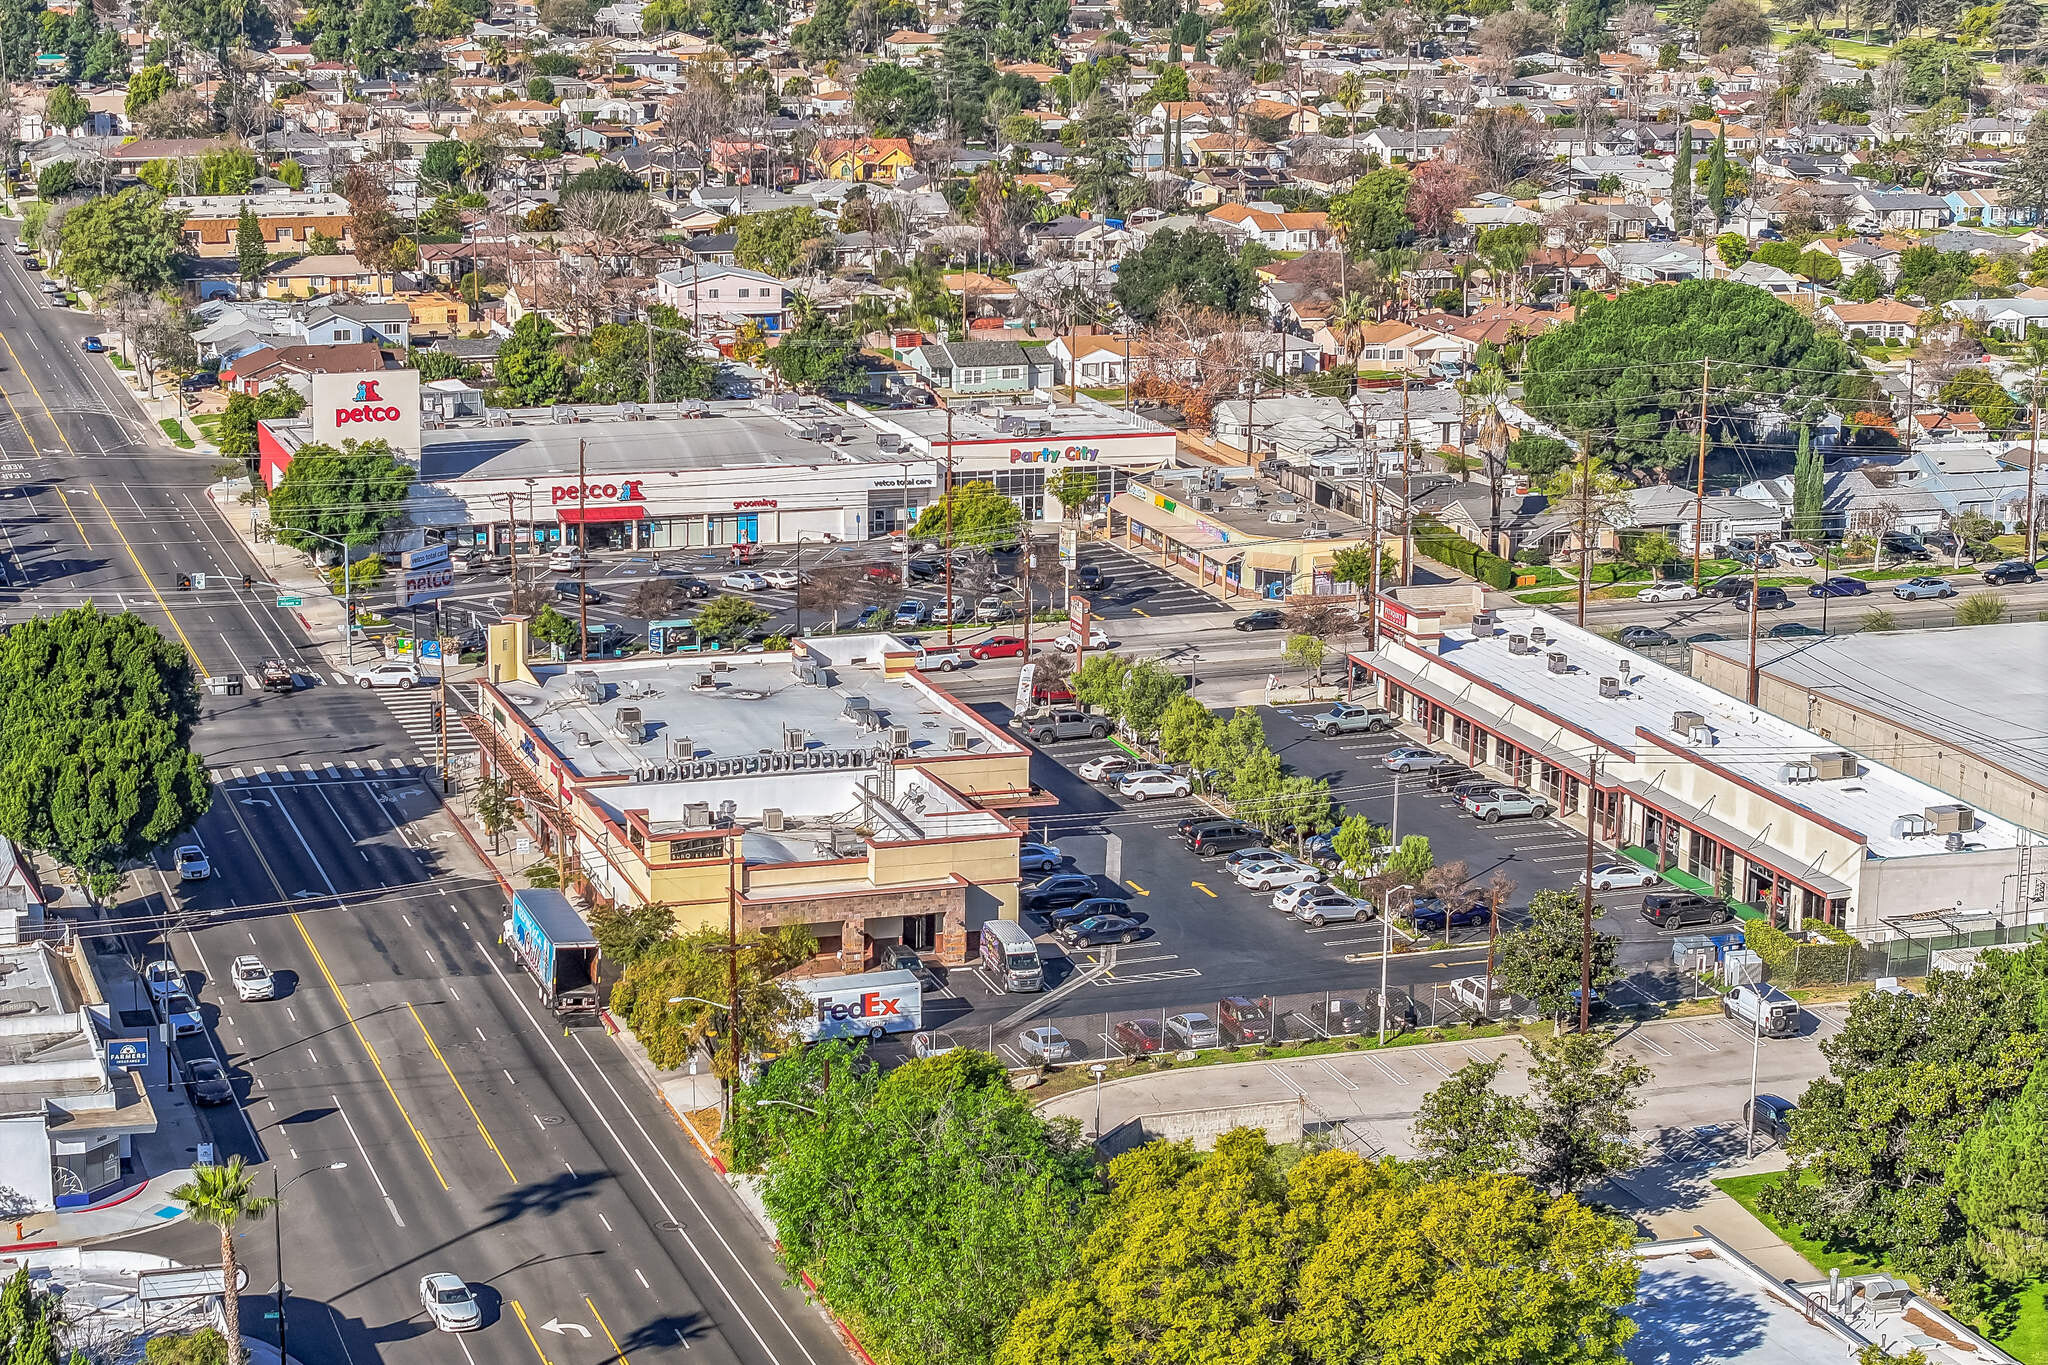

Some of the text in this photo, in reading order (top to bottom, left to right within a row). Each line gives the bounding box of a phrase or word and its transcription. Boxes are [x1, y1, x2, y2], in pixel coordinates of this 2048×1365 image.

[336, 405, 400, 427] petco
[1010, 446, 1099, 463] Party City
[552, 482, 617, 504] petco
[733, 498, 777, 509] grooming
[818, 992, 900, 1022] FedEx
